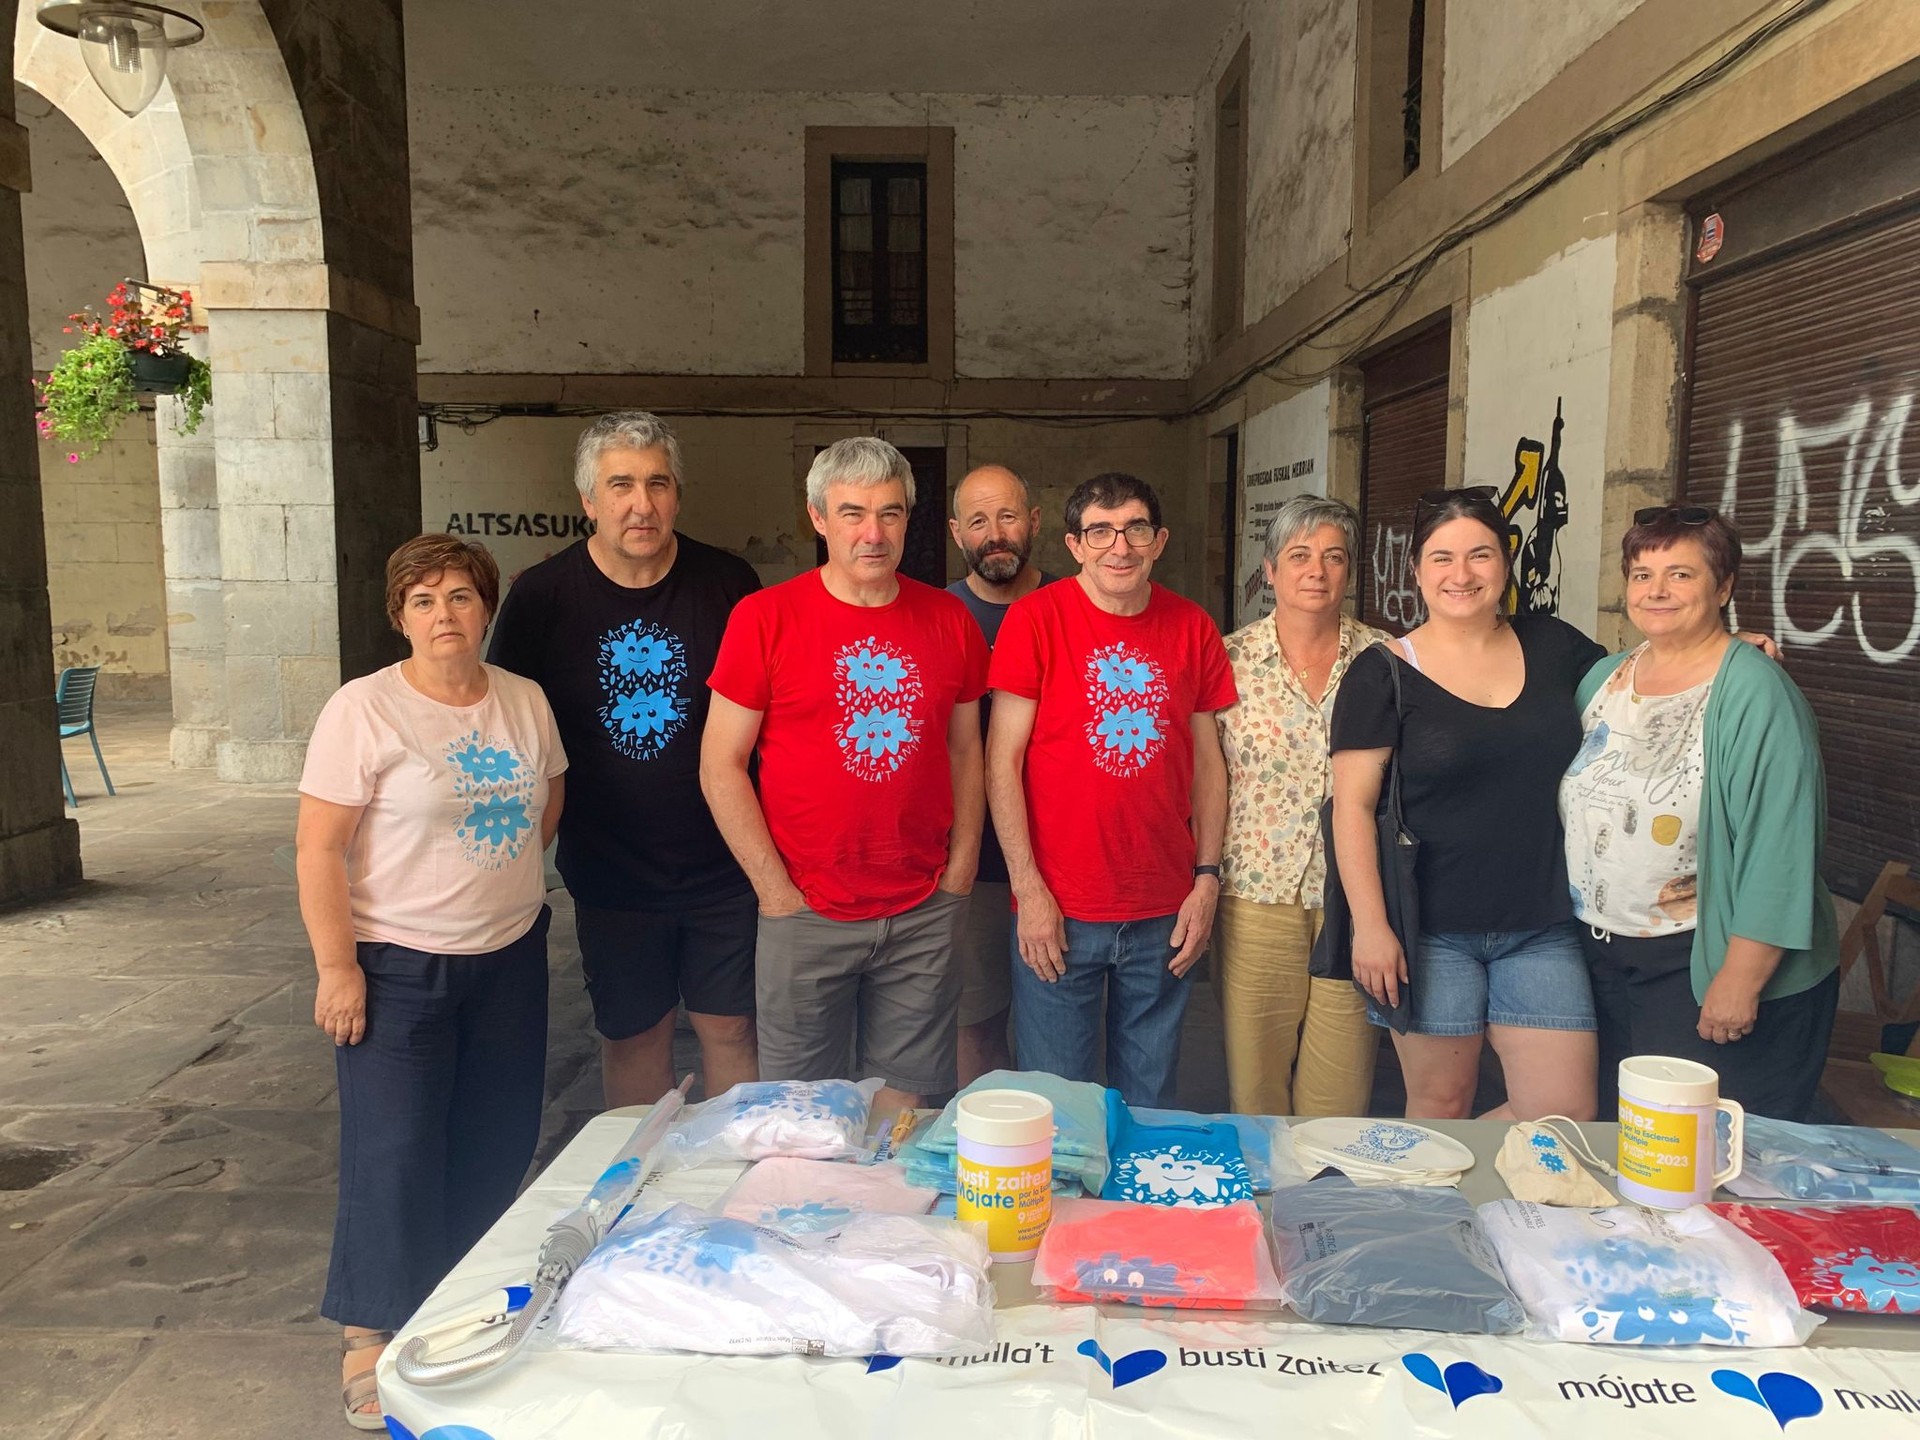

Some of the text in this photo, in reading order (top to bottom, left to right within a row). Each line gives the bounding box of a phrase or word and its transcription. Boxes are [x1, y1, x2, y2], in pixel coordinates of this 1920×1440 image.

[446, 512, 597, 538] ALTSASUK
[1642, 1131, 1680, 1143] Esclerosis
[1656, 1153, 1689, 1168] 2023
[995, 1169, 1048, 1191] zaitez
[1017, 1211, 1026, 1224] 9
[1179, 1347, 1386, 1378] busti zaitez
[1557, 1373, 1698, 1409] mójate
[1833, 1388, 1920, 1413] mull
